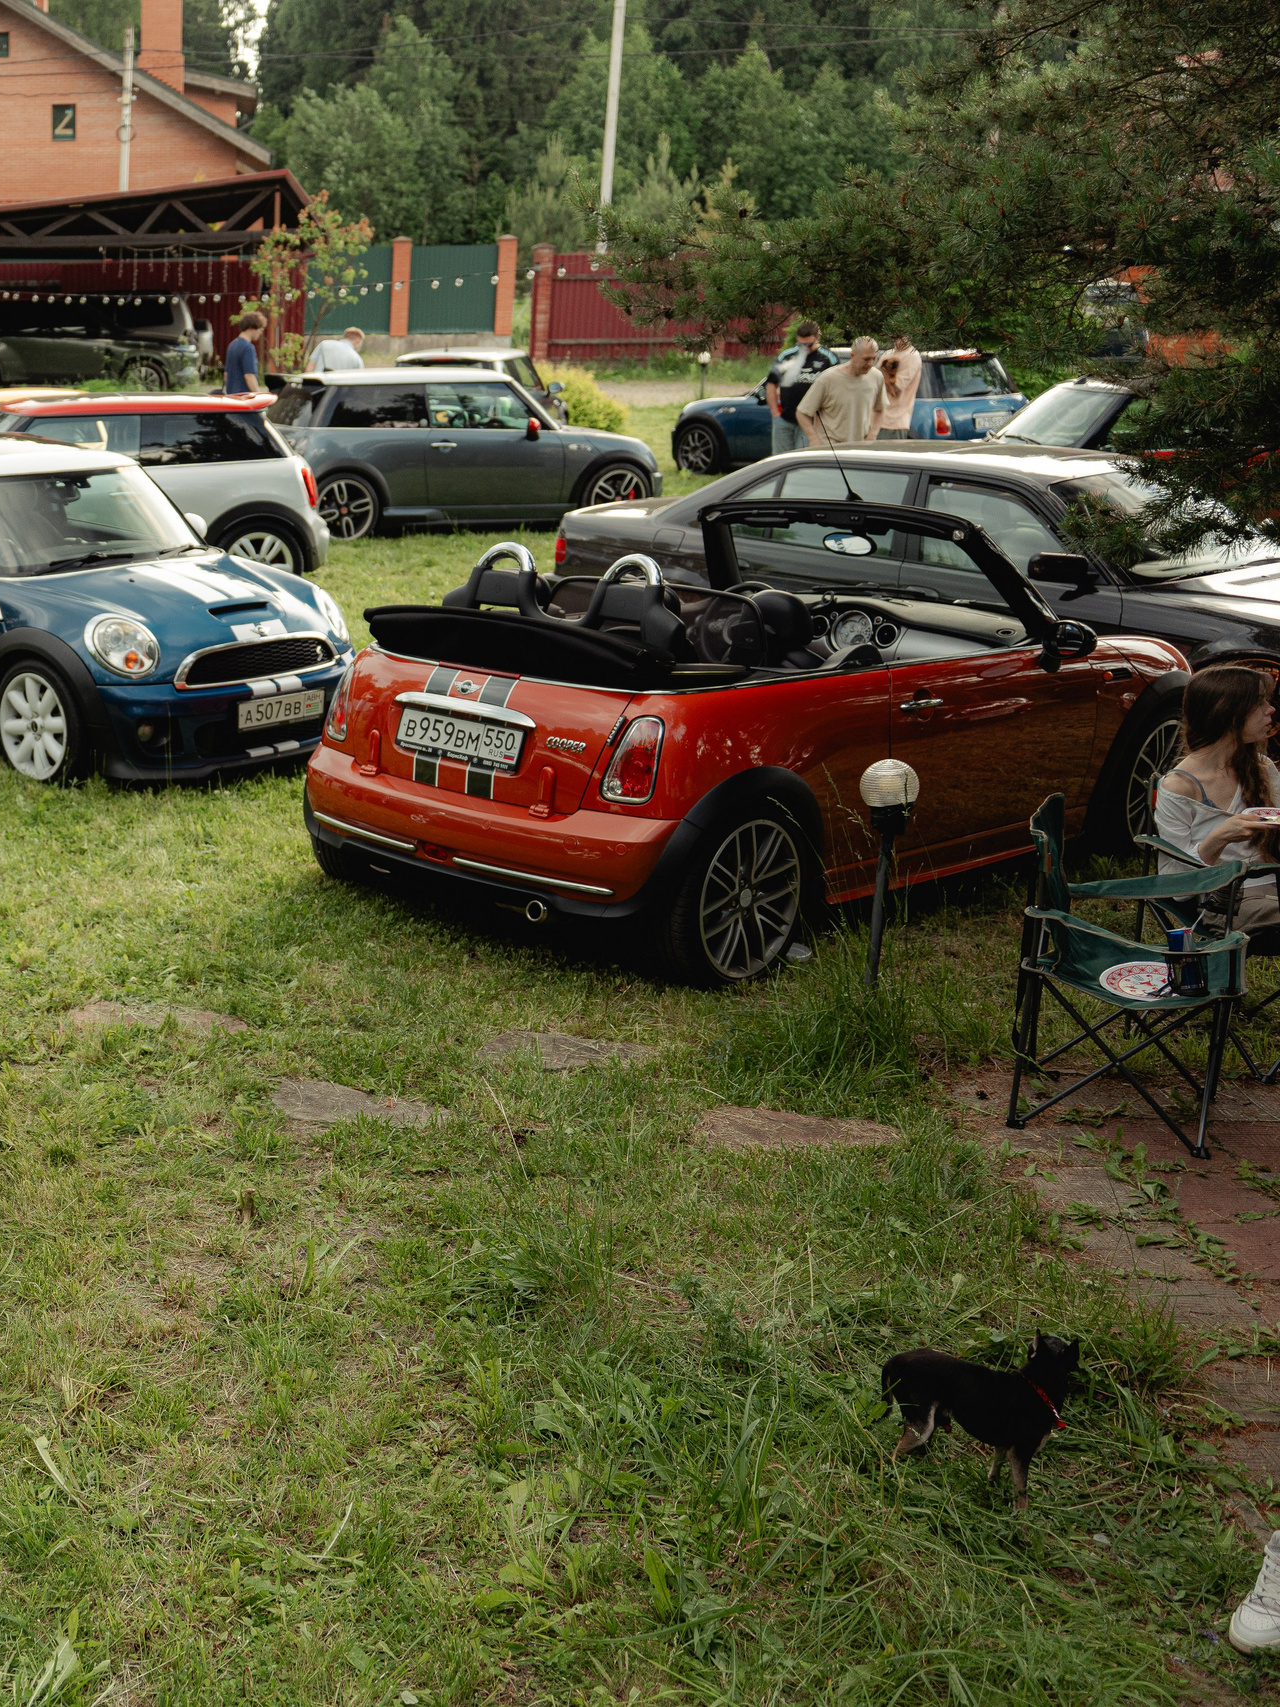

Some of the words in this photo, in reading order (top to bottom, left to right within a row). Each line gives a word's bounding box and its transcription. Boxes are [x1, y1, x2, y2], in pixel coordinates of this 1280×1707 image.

[483, 728, 516, 751] 550
[546, 736, 587, 754] COOPER
[488, 749, 504, 758] RUS
